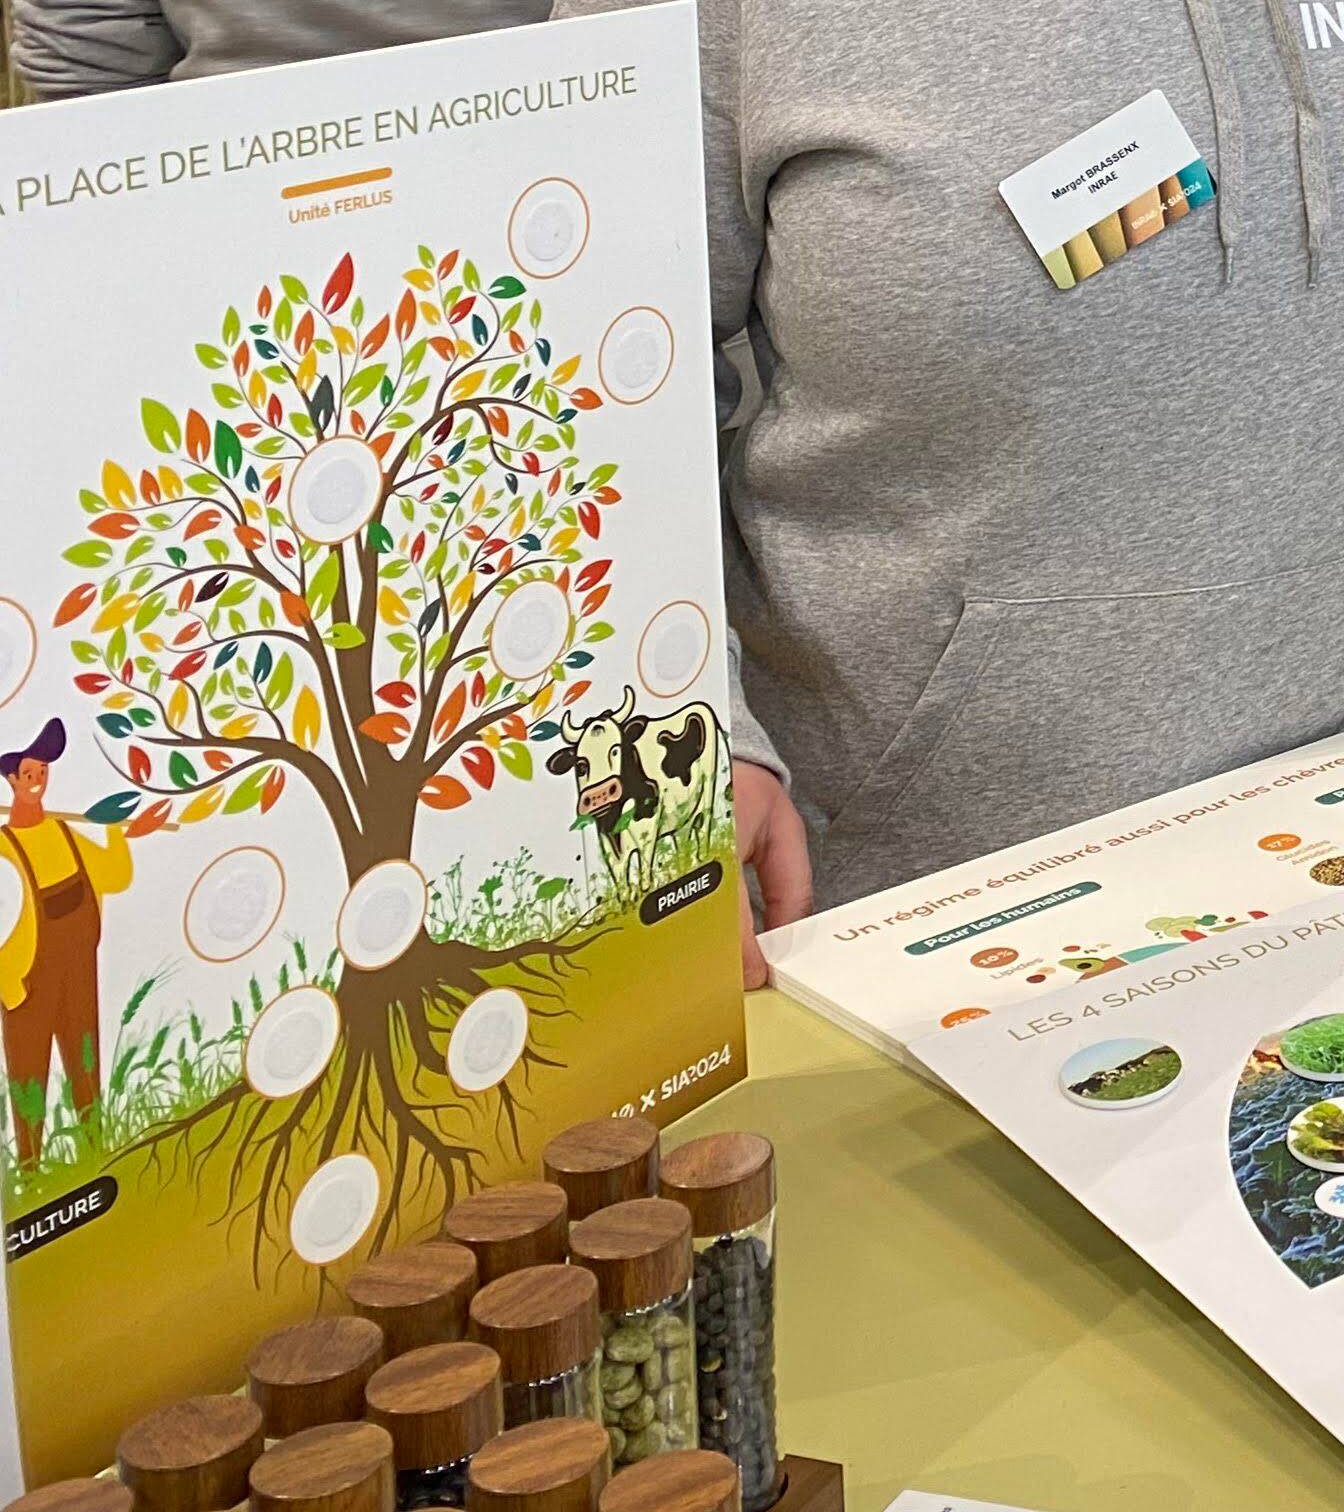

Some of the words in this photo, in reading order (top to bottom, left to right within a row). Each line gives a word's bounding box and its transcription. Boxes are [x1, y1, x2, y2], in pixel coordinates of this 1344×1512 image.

[17, 157, 149, 212] PLACE
[159, 145, 212, 185] DE
[222, 116, 365, 172] L'ARBRE
[374, 106, 418, 143] EN
[428, 66, 638, 133] AGRICULTURE
[1051, 174, 1087, 199] Margot
[1088, 171, 1118, 193] INRAE
[289, 203, 331, 224] Unité
[334, 190, 394, 216] FERLUS
[834, 922, 881, 942] Un
[883, 886, 982, 926] régime
[986, 842, 1102, 890] équilibré
[1105, 819, 1171, 848] aussi
[1172, 794, 1230, 824] pour
[1229, 784, 1271, 801] les
[658, 873, 711, 912] PRAIRIE
[924, 926, 970, 948] Pour
[969, 917, 1002, 932] les
[1001, 888, 1082, 920] humains
[990, 958, 1044, 979] Lipides
[1007, 1011, 1072, 1041] LES
[1082, 1005, 1100, 1018] 4
[1102, 952, 1240, 1008] SAISONS
[1241, 934, 1289, 960] DU
